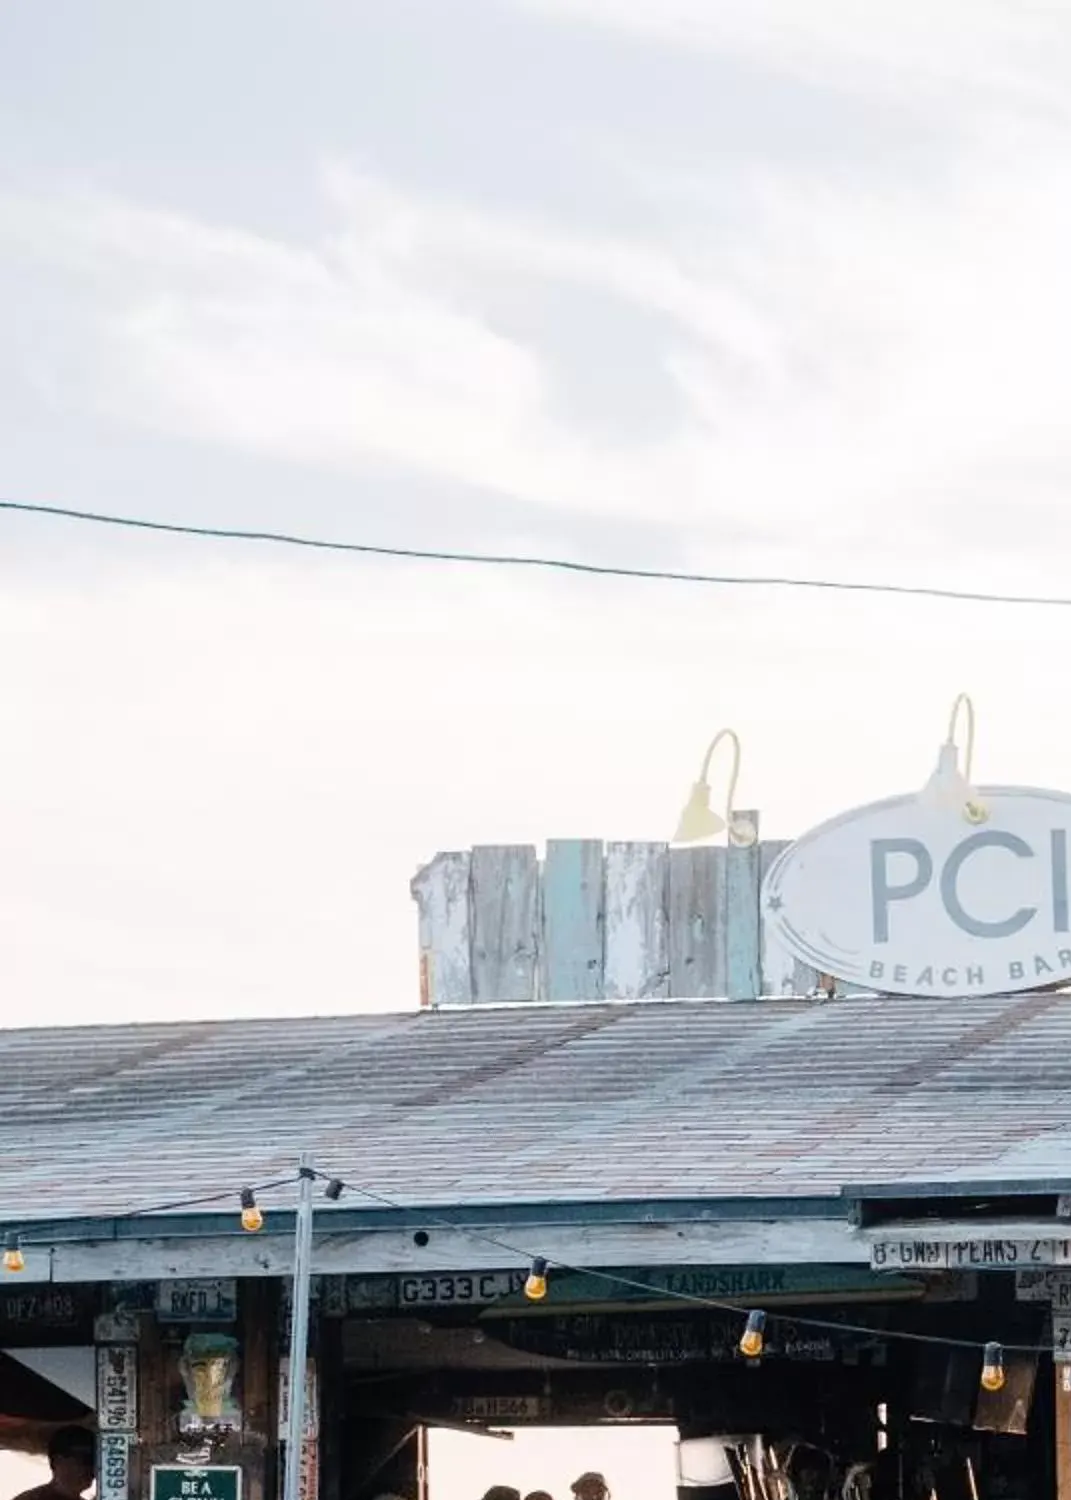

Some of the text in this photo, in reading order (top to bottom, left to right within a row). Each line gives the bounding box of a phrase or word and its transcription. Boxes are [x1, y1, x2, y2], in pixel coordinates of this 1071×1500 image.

[870, 828, 1070, 944] PCI
[869, 958, 984, 987] BEACH
[402, 1278, 474, 1303] G333
[181, 1481, 212, 1496] BE A
